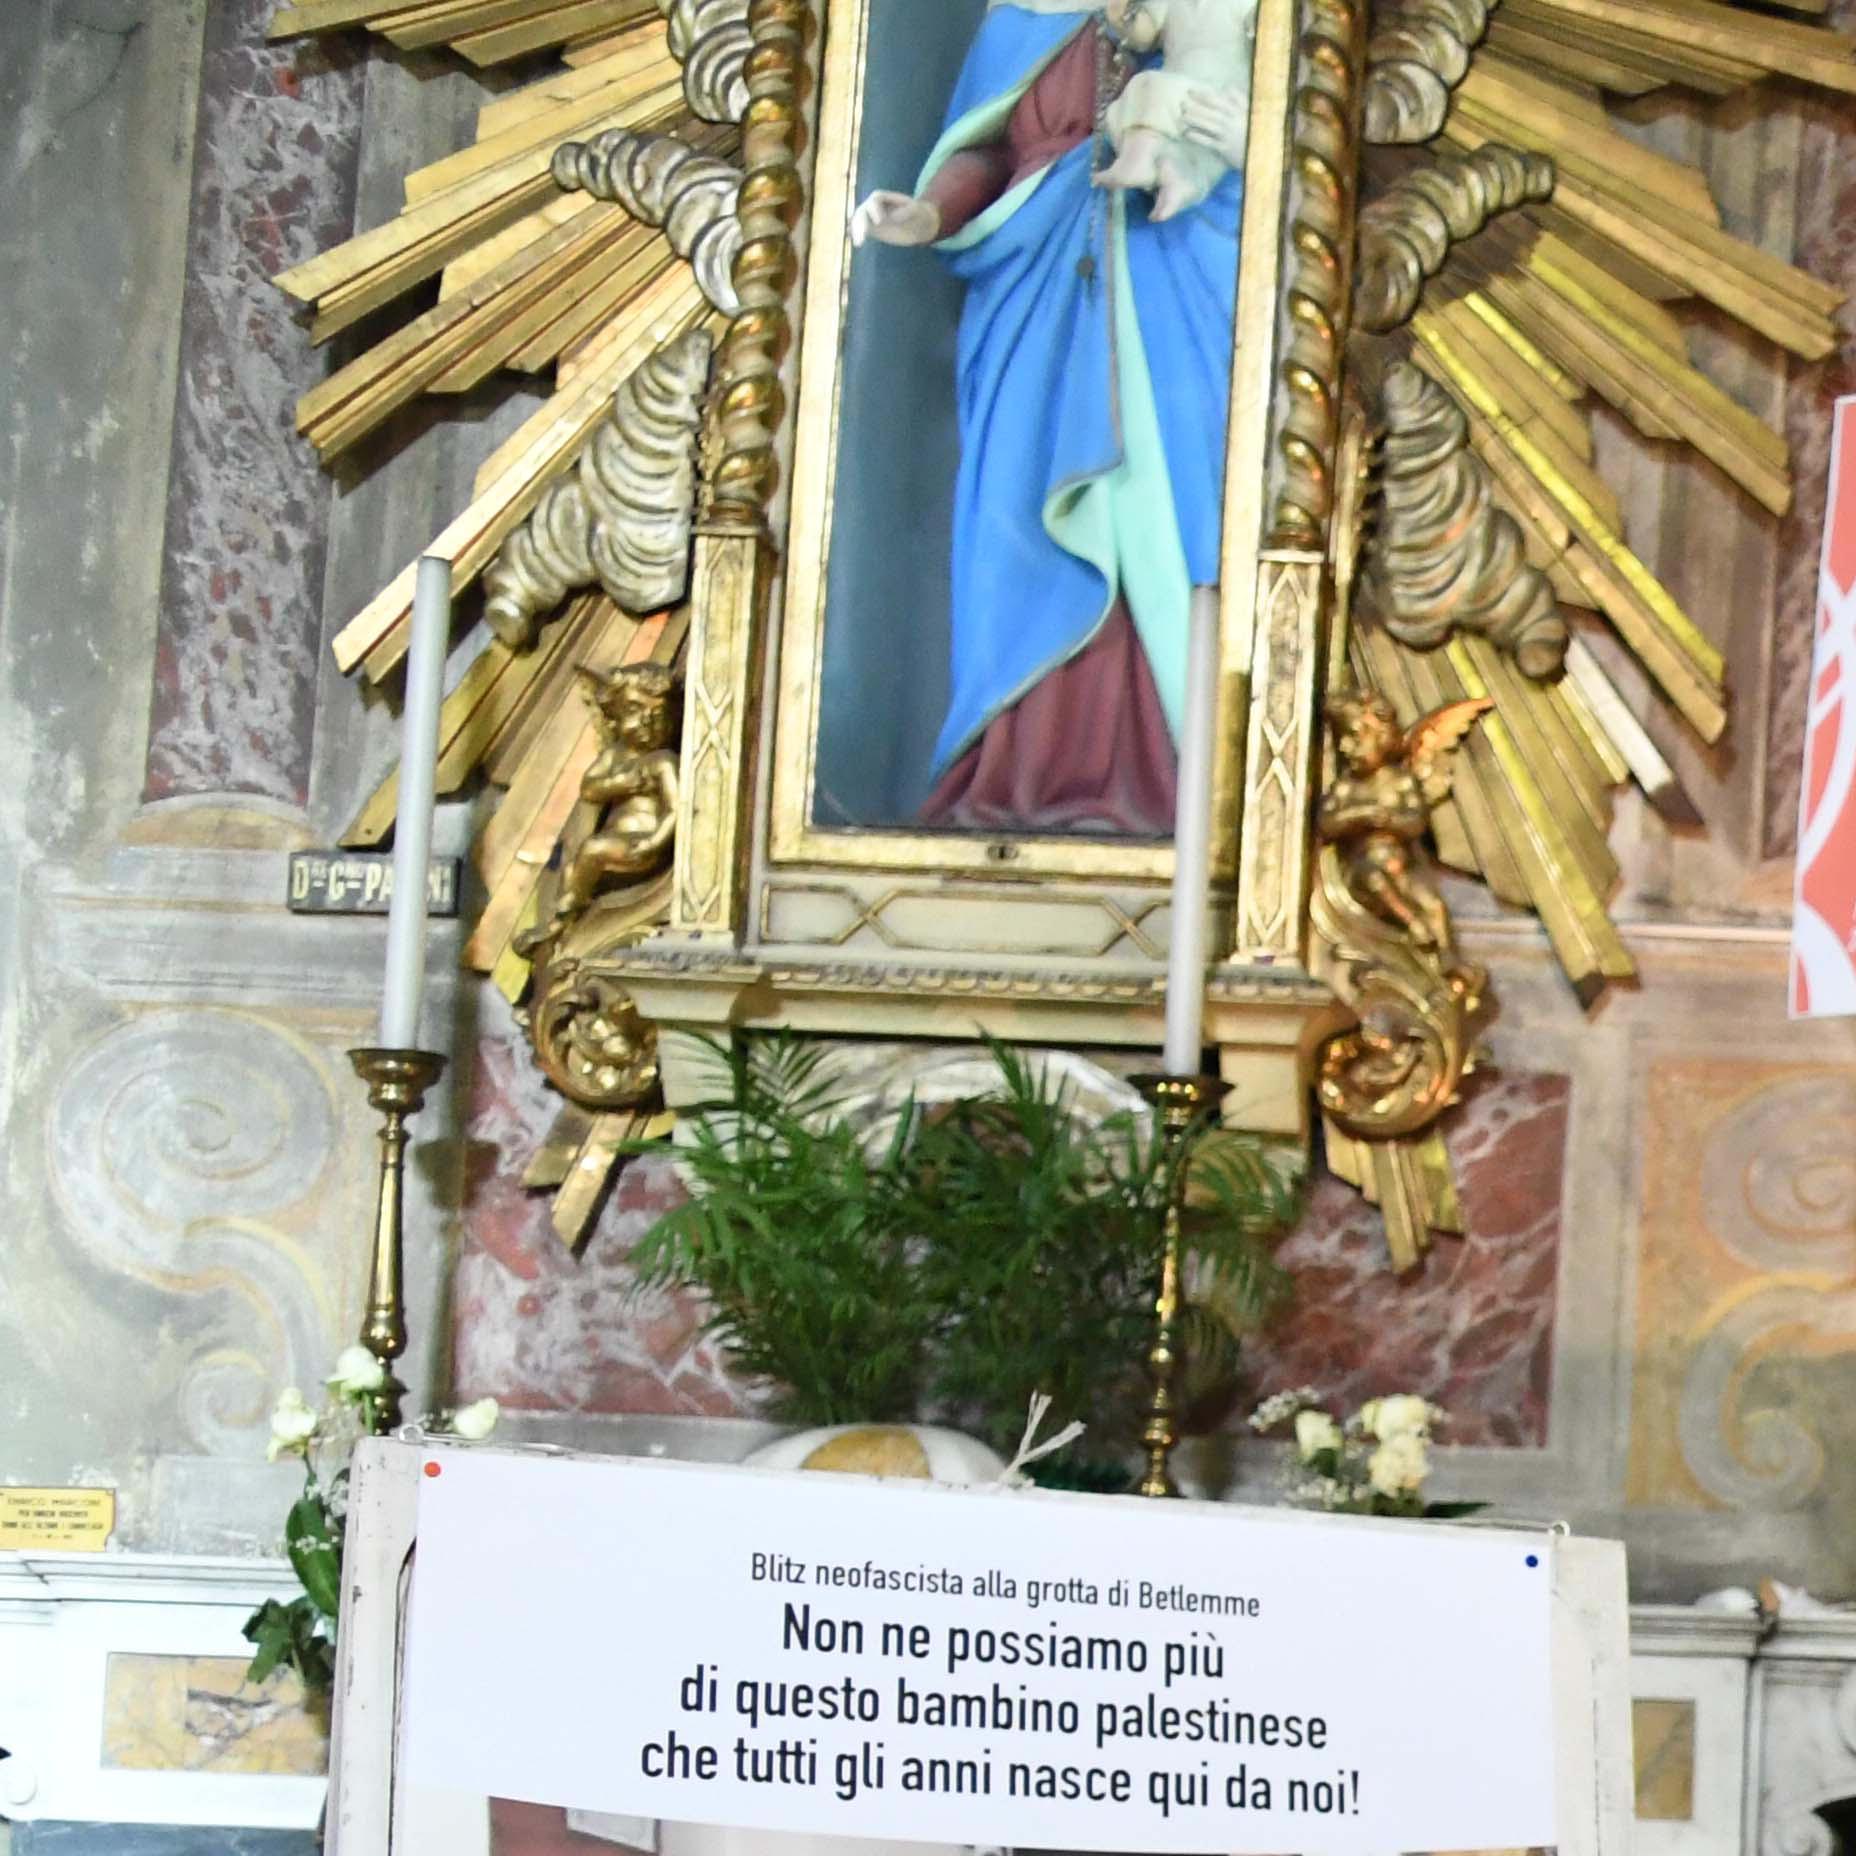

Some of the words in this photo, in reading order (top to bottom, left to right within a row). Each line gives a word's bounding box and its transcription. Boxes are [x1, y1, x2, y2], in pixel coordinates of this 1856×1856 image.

[750, 1551, 807, 1585] Blitz
[815, 1559, 964, 1596] neofascista
[972, 1568, 1018, 1600] alla
[1026, 1577, 1099, 1609] grotta
[1107, 1578, 1130, 1608] di
[1138, 1580, 1261, 1619] Betlemme
[782, 1601, 864, 1655] Non
[881, 1622, 931, 1660] ne
[947, 1620, 1148, 1675] possiamo
[1164, 1630, 1225, 1689] più
[680, 1662, 719, 1713] di
[735, 1676, 880, 1730] questo
[896, 1676, 1080, 1735] bambino
[1095, 1692, 1328, 1751] palestinese
[640, 1729, 719, 1781] che
[732, 1737, 817, 1786] tutti
[834, 1740, 885, 1802] gli
[900, 1747, 992, 1796] anni
[1008, 1762, 1132, 1804] nasce
[1148, 1760, 1209, 1819] qui
[1225, 1762, 1272, 1811] da
[1287, 1768, 1360, 1817] noi!
